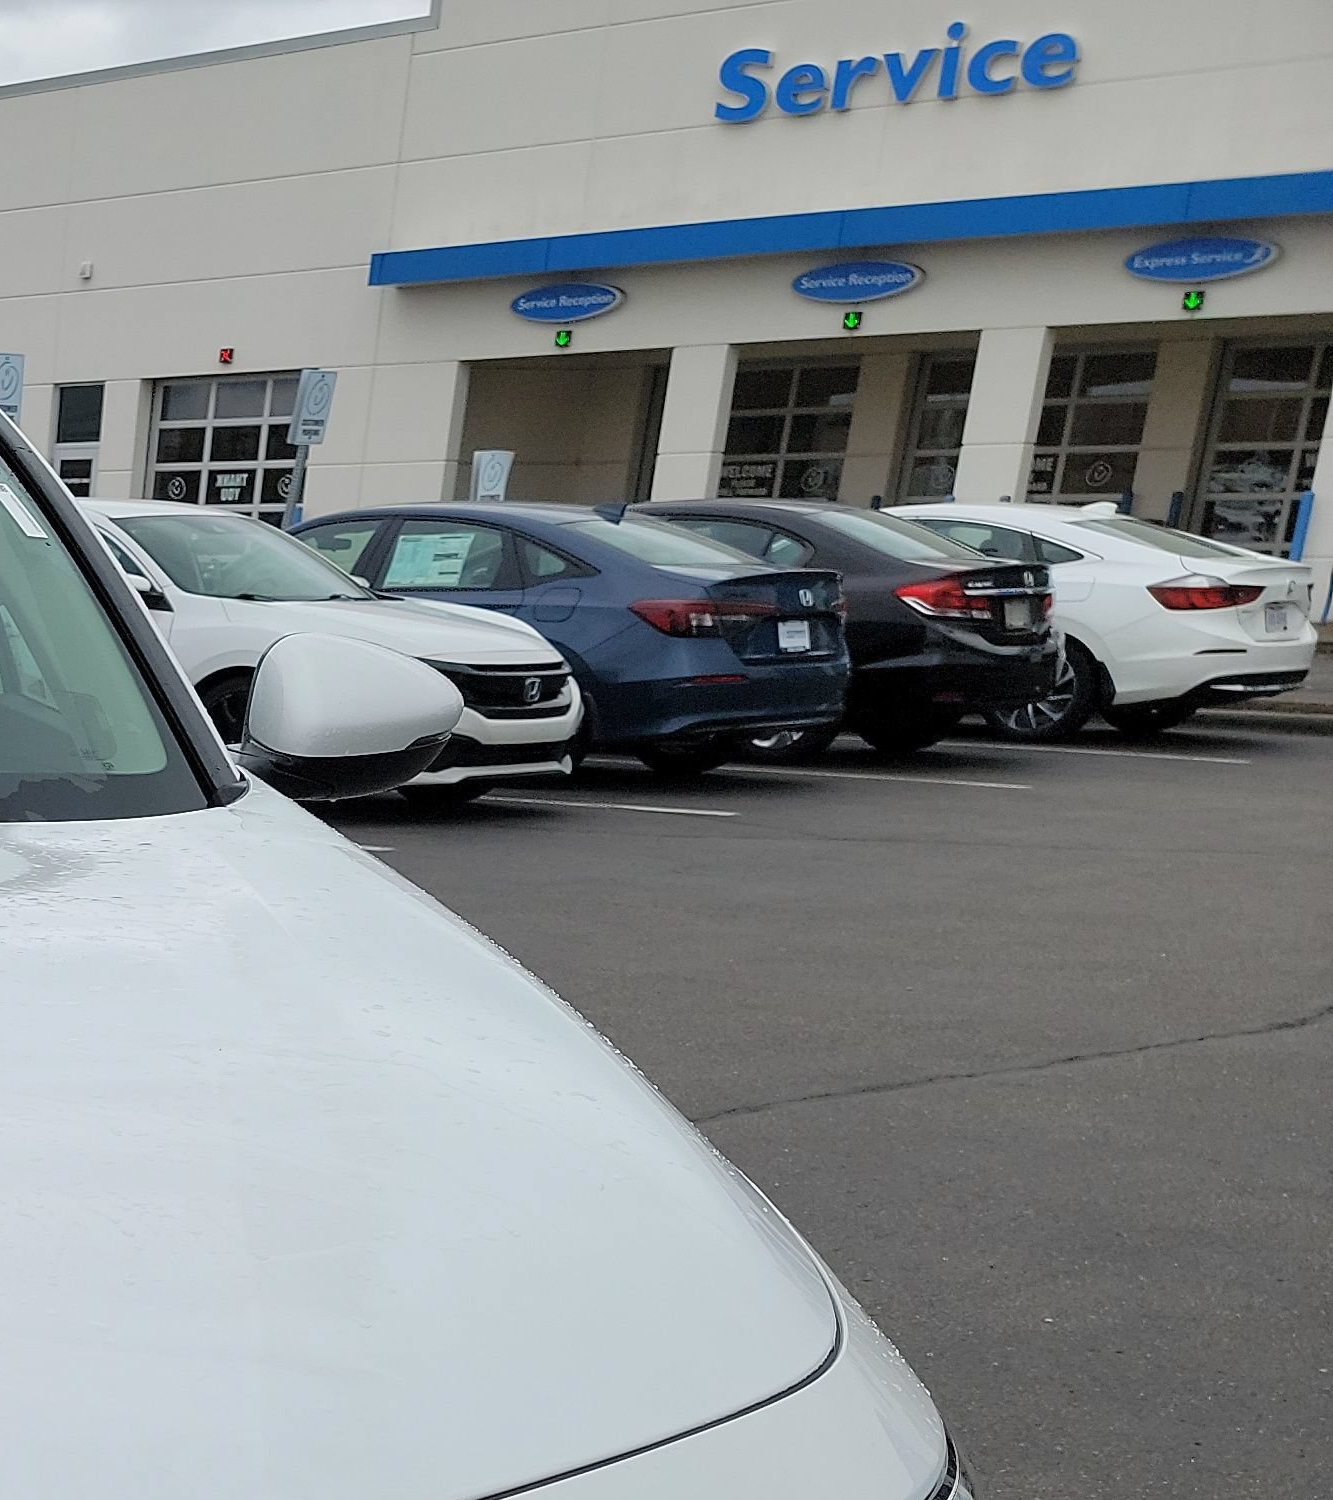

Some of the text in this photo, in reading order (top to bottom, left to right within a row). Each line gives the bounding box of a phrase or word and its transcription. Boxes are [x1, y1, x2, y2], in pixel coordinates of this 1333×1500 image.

[714, 21, 1078, 124] Service
[1134, 252, 1243, 269] Express Service
[800, 273, 912, 289] Service Reception
[517, 299, 556, 309] Service
